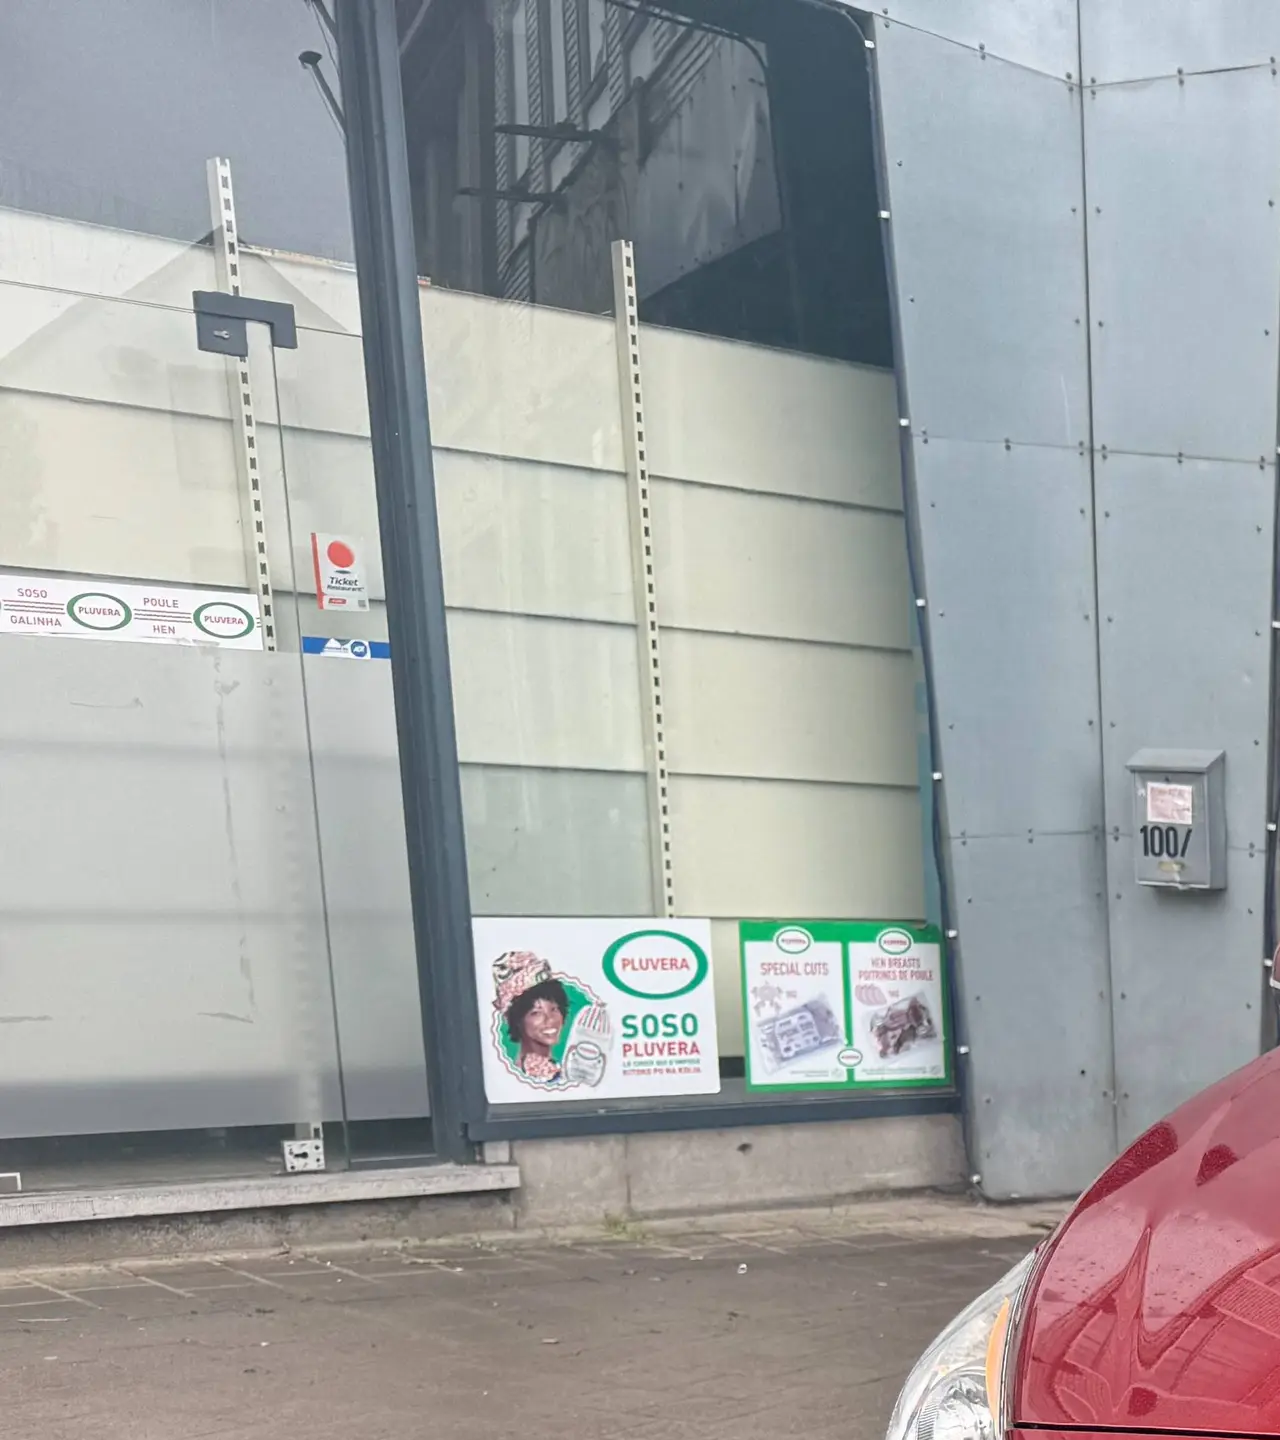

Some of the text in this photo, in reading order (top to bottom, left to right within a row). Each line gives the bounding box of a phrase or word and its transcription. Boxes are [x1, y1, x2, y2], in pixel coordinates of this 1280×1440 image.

[329, 577, 359, 587] Ticket
[17, 587, 48, 599] SOSO
[143, 597, 179, 608] POULE
[78, 606, 121, 617] PLUVERA
[10, 615, 62, 627] GALINHA
[204, 615, 244, 625] PLUVERA
[152, 624, 175, 634] HEN
[621, 957, 691, 972] PLUVERA
[760, 962, 829, 976] SPECIAL CUTS
[621, 1013, 699, 1039] SOSO
[622, 1042, 701, 1058] PLUVERA
